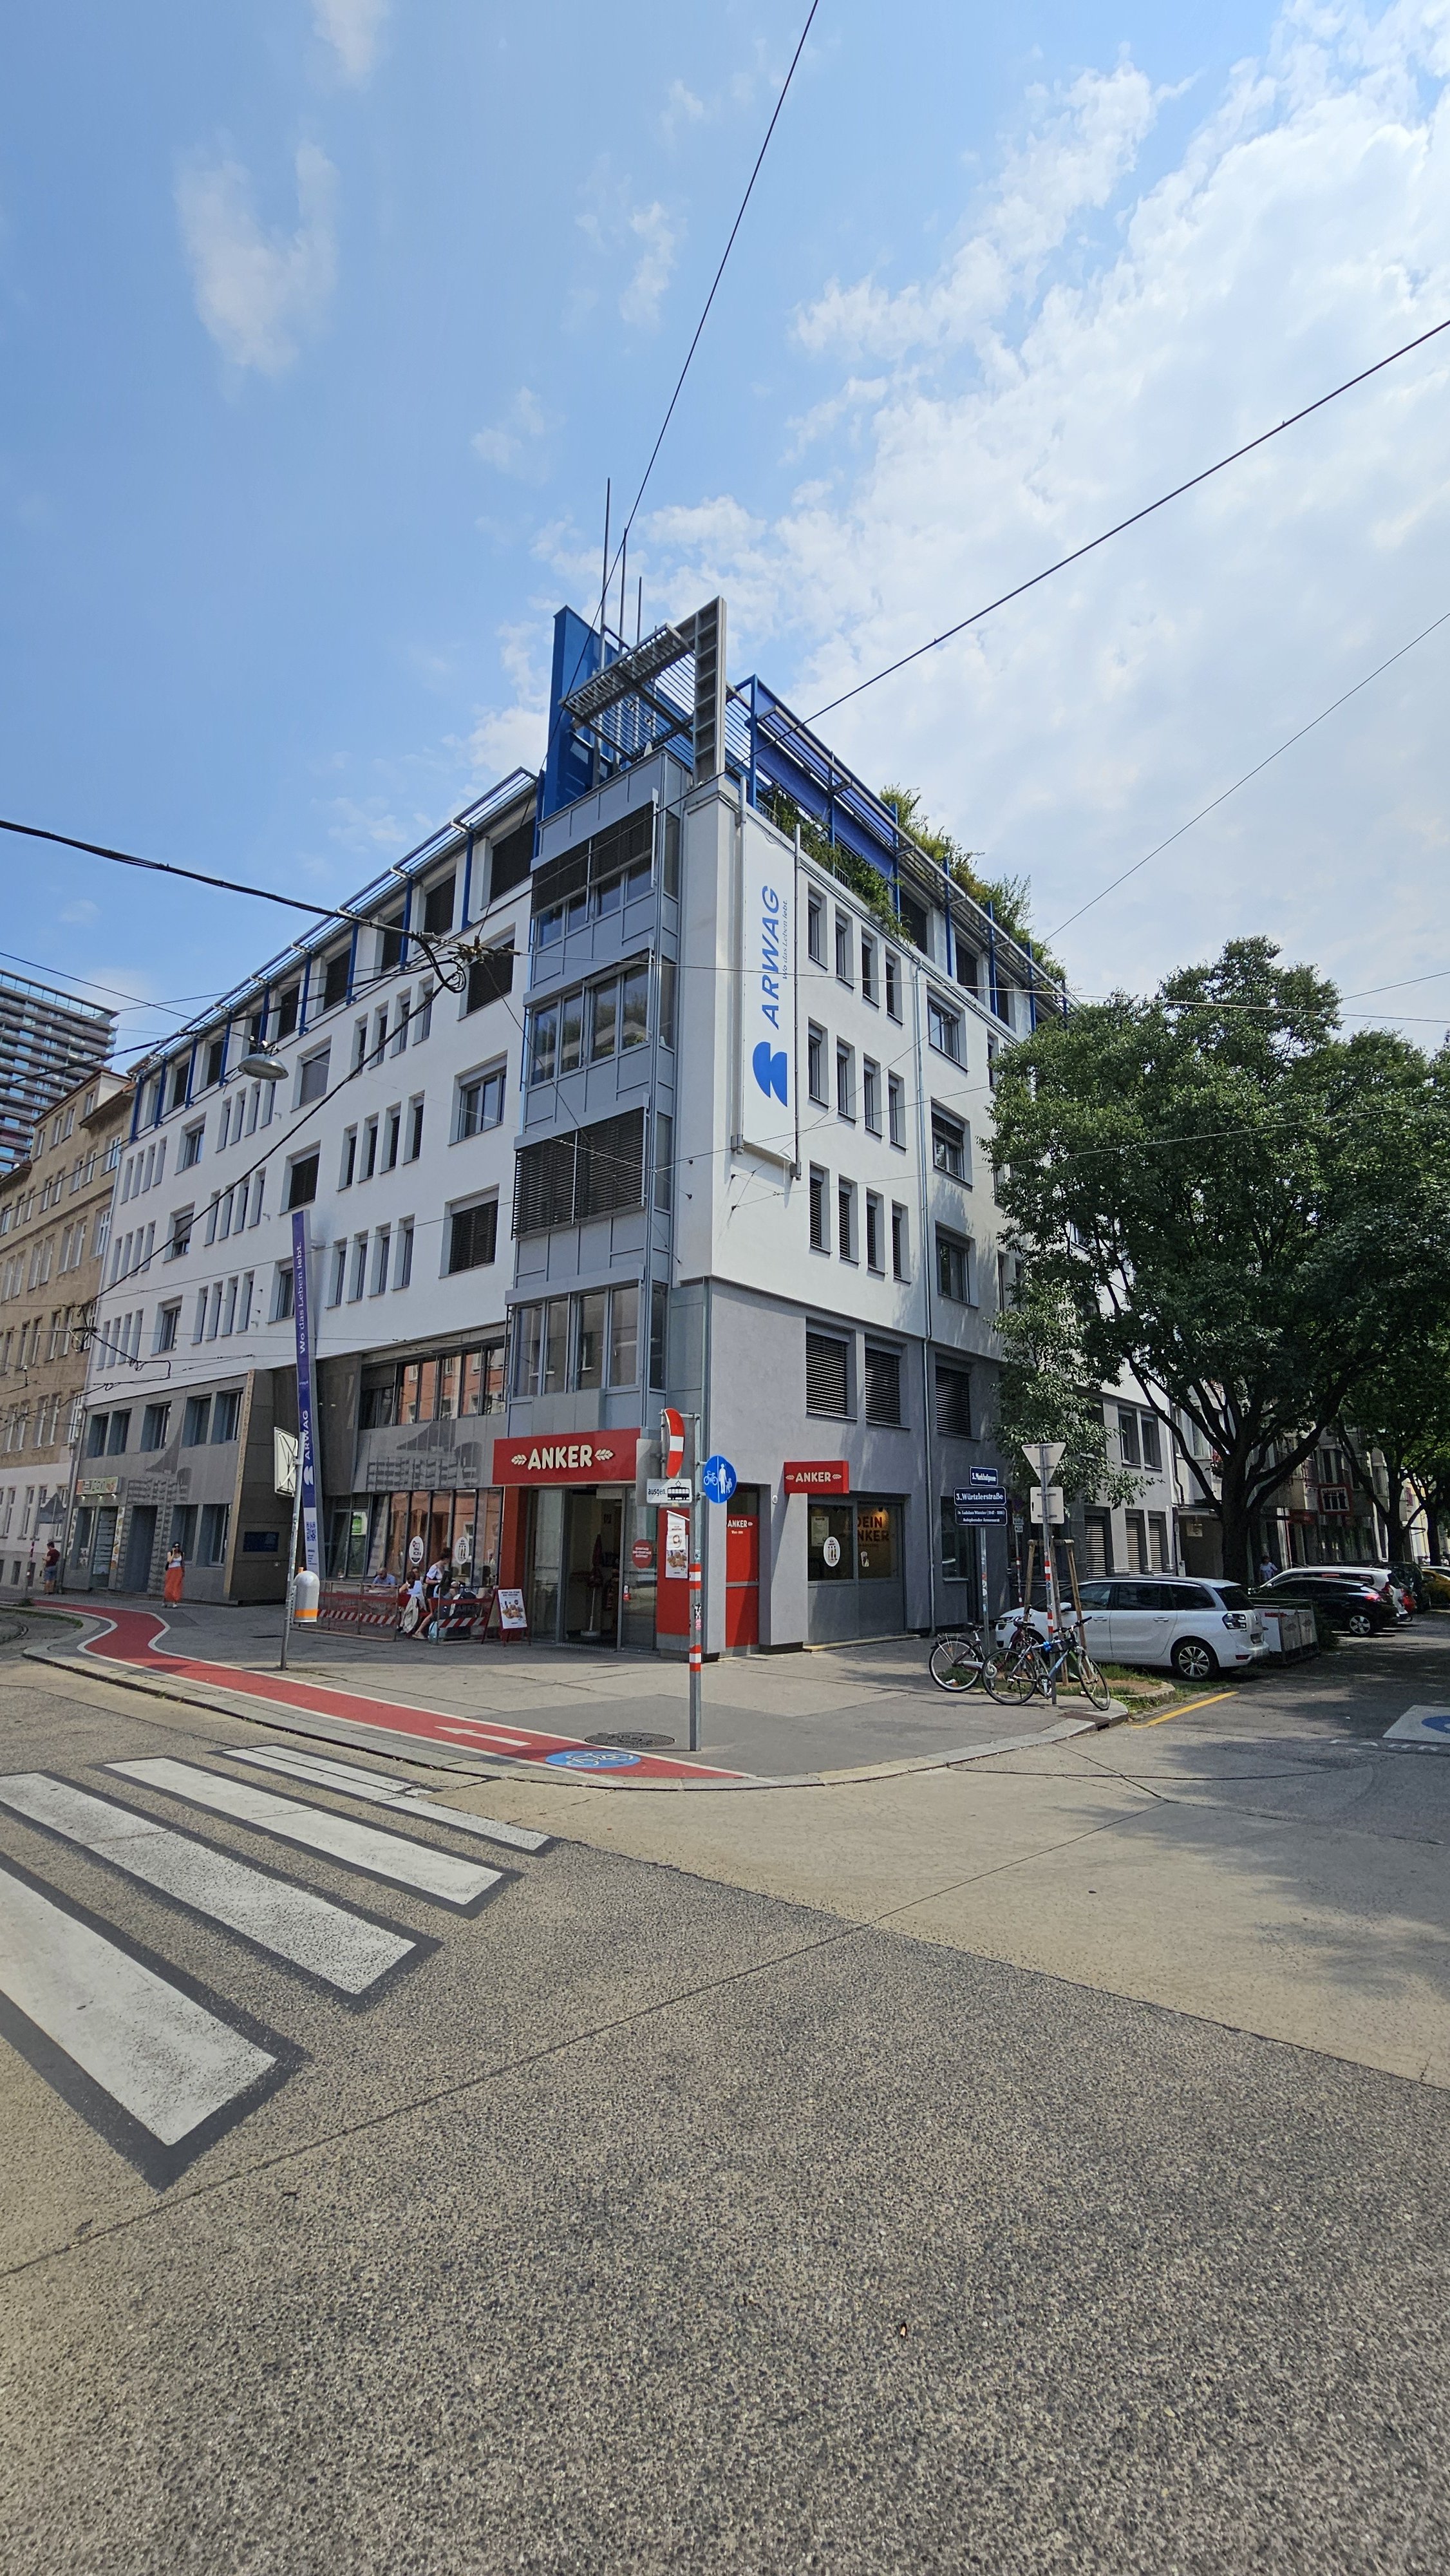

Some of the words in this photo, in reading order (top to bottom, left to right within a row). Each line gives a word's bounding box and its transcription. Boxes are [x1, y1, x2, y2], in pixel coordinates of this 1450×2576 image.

[762, 886, 779, 1030] ARWAG
[782, 965, 787, 980] Wo
[299, 1334, 306, 1354] Wo
[527, 1444, 592, 1470] ANKER
[795, 1472, 831, 1482] ANKER
[648, 1488, 666, 1497] ausgen.
[857, 1530, 889, 1542] NKER
